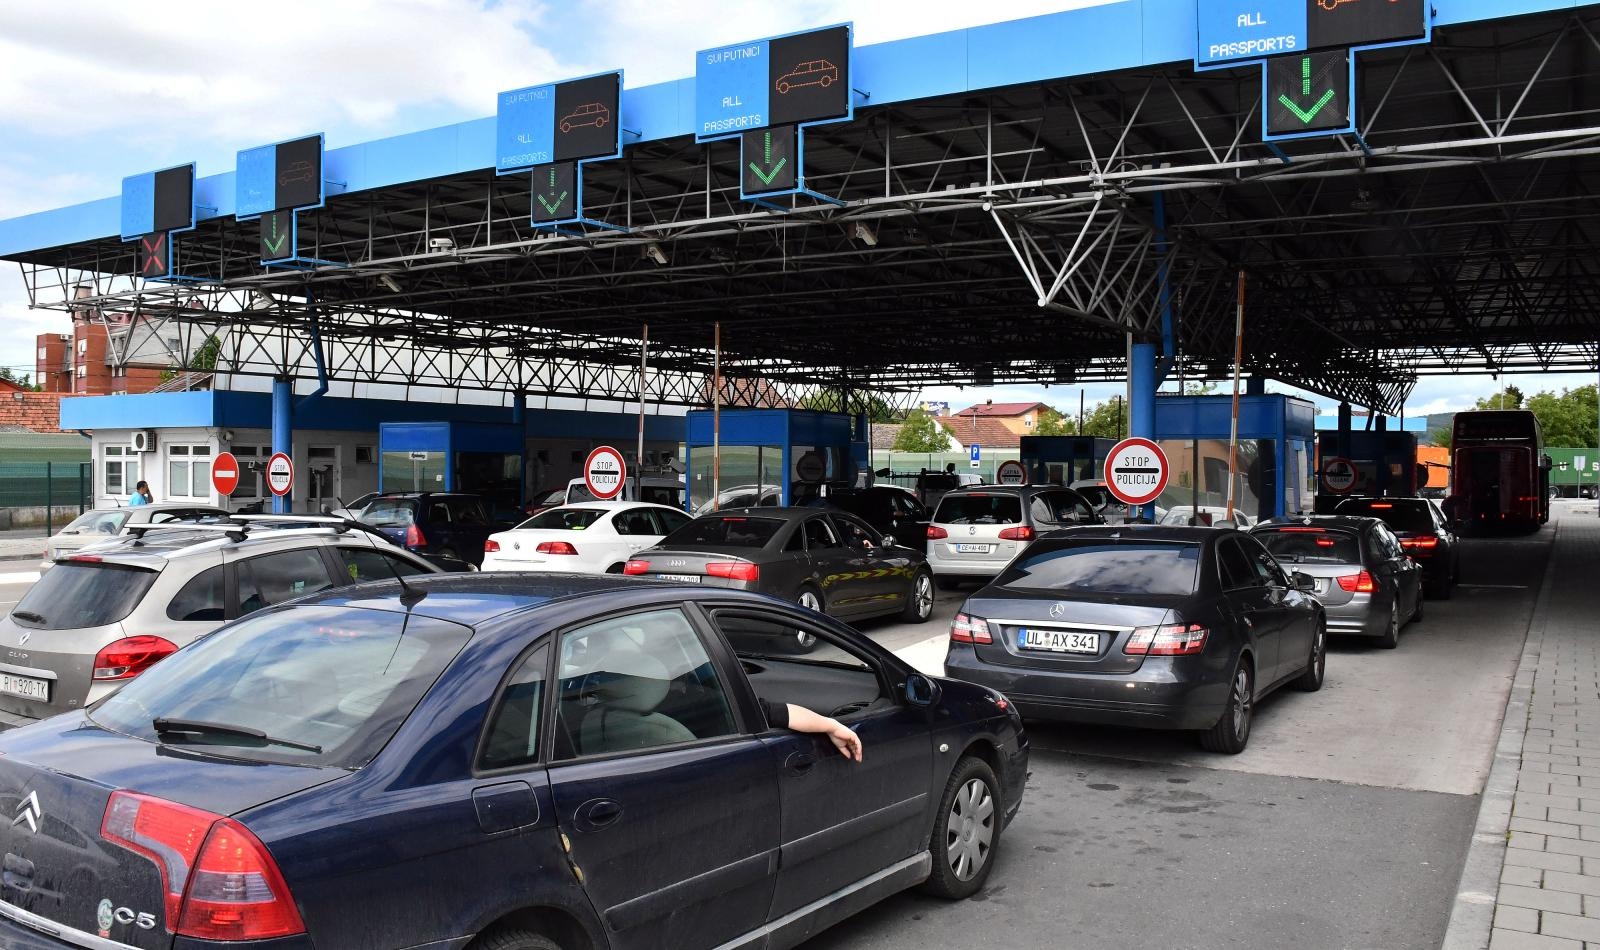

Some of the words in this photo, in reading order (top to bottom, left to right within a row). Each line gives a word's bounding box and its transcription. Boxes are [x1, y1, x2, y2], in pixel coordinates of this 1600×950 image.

[1237, 12, 1267, 27] ALL
[1210, 35, 1296, 58] PASSPORTS
[723, 46, 760, 62] PUTNICI
[722, 95, 743, 108] ALL
[704, 114, 762, 132] PASSPORTS
[502, 151, 548, 166] PASSPORTS
[972, 446, 978, 458] P
[274, 464, 286, 472] STOP
[596, 461, 613, 470] STOP
[1124, 456, 1150, 467] STOP
[591, 475, 617, 484] POLICIJA
[1116, 474, 1157, 485] POLICIJA
[1026, 631, 1043, 646] UL
[1051, 633, 1069, 648] AX
[1071, 635, 1096, 649] 341
[8, 651, 29, 659] CLIO
[4, 676, 12, 691] RI
[113, 906, 156, 930] C5
